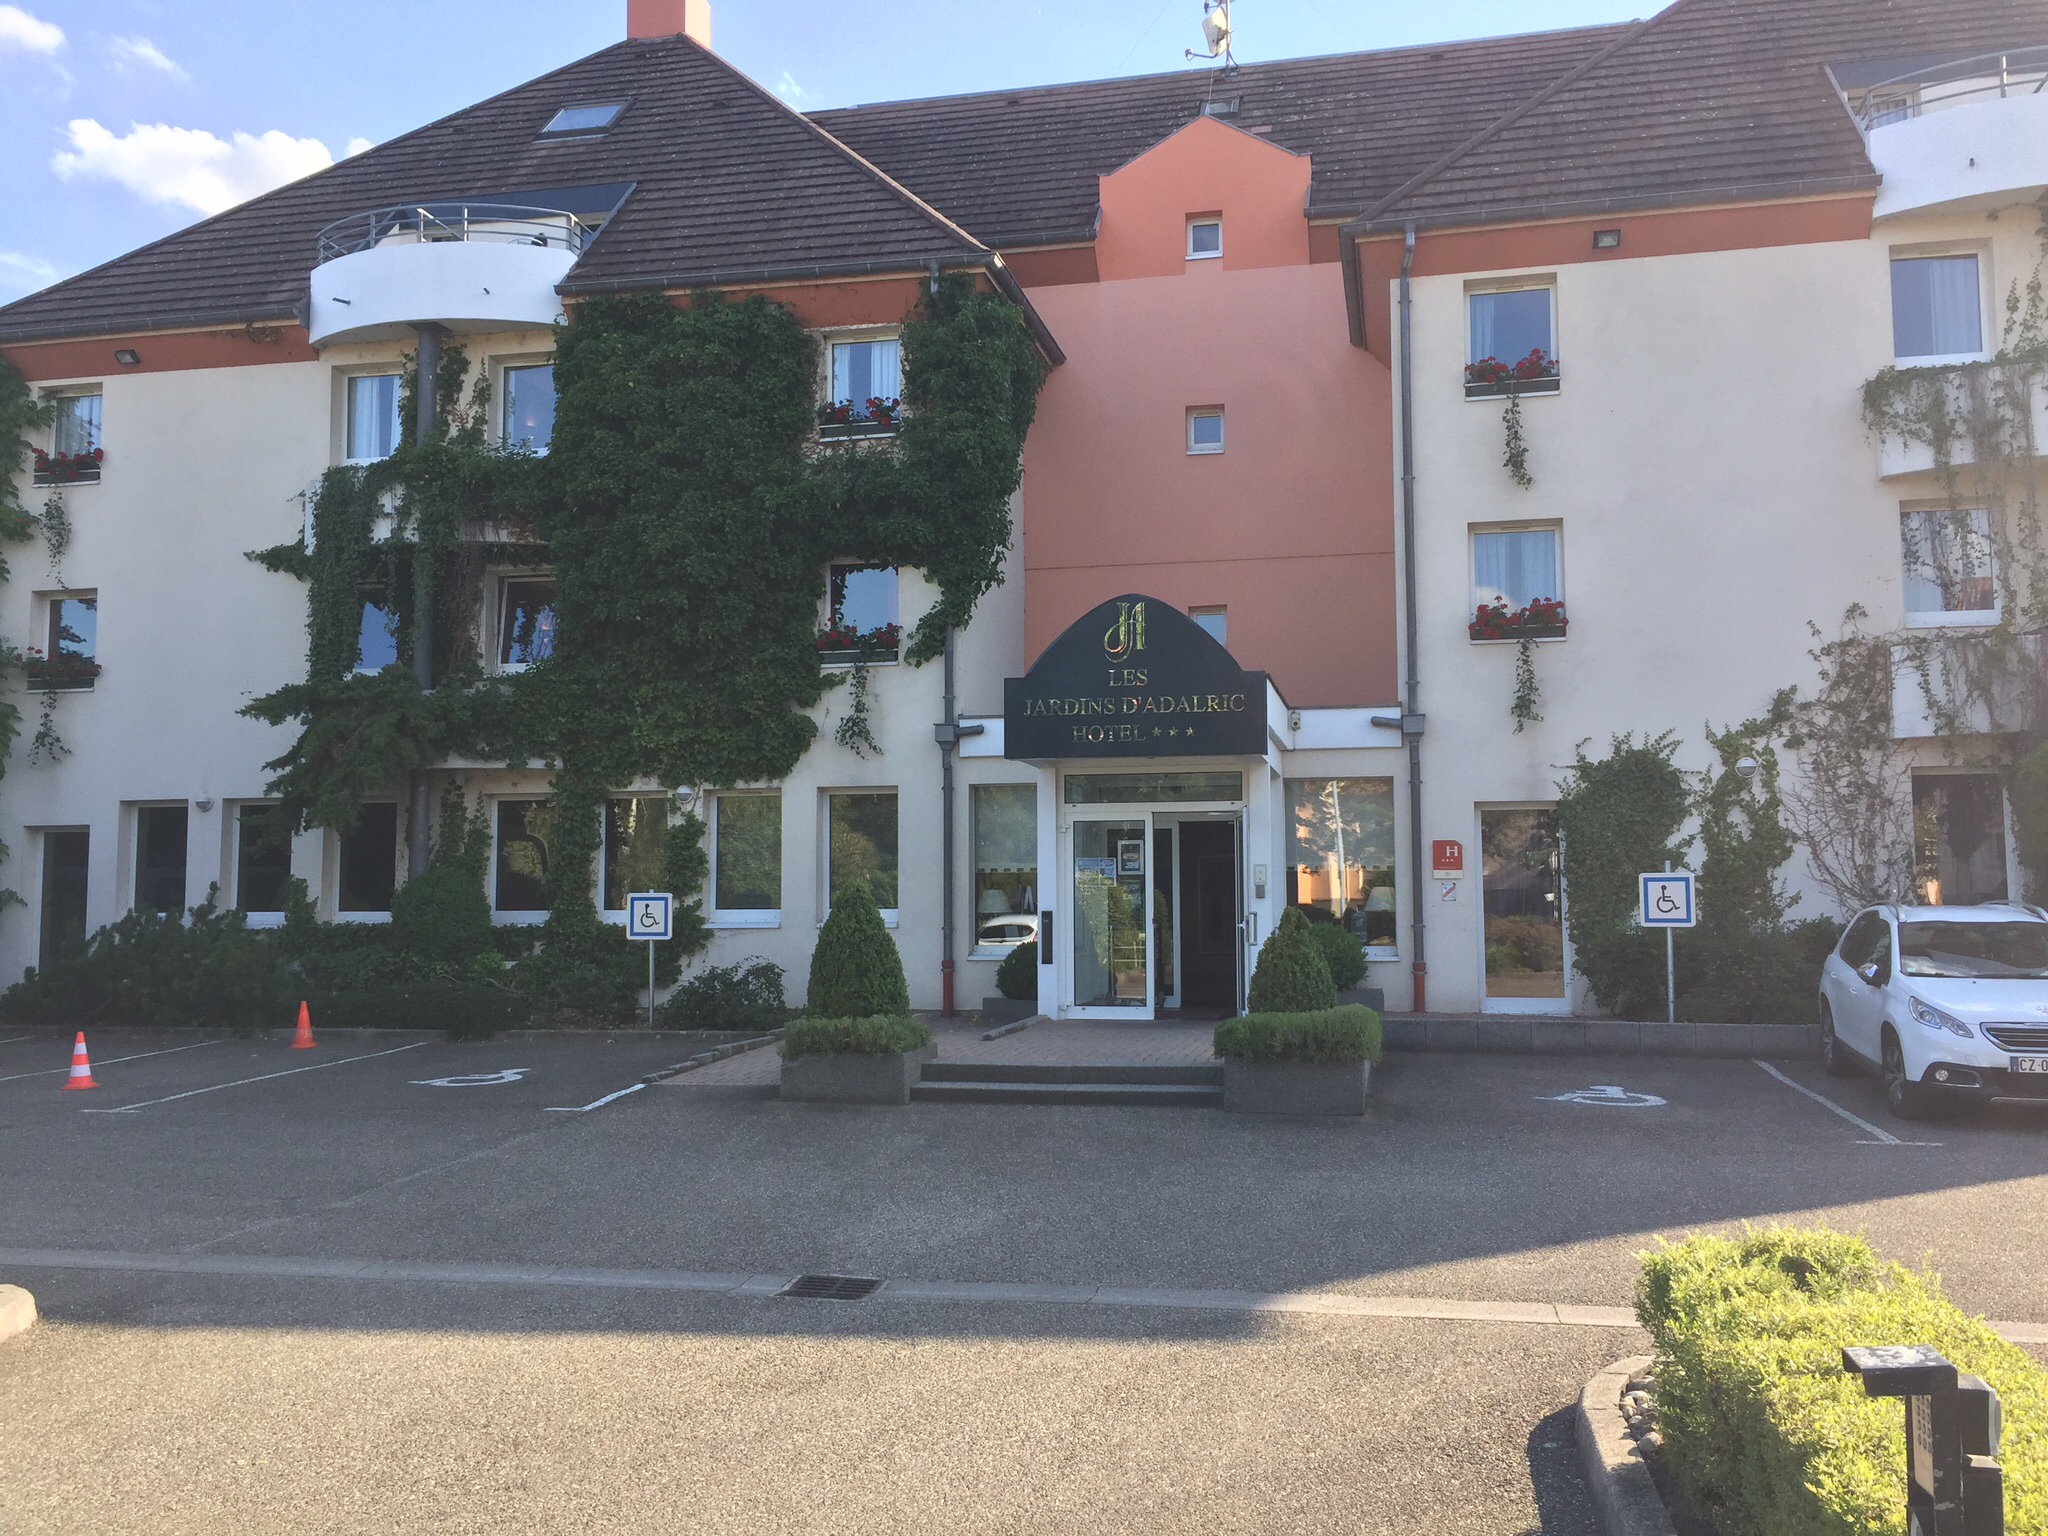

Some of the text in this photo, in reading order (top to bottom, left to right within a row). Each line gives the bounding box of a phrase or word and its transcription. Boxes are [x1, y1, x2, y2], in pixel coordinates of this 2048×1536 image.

[1108, 669, 1148, 687] LES
[1023, 694, 1245, 716] JARDINS D'ADALRIC
[1072, 724, 1146, 743] HOTEL
[1445, 845, 1458, 857] H
